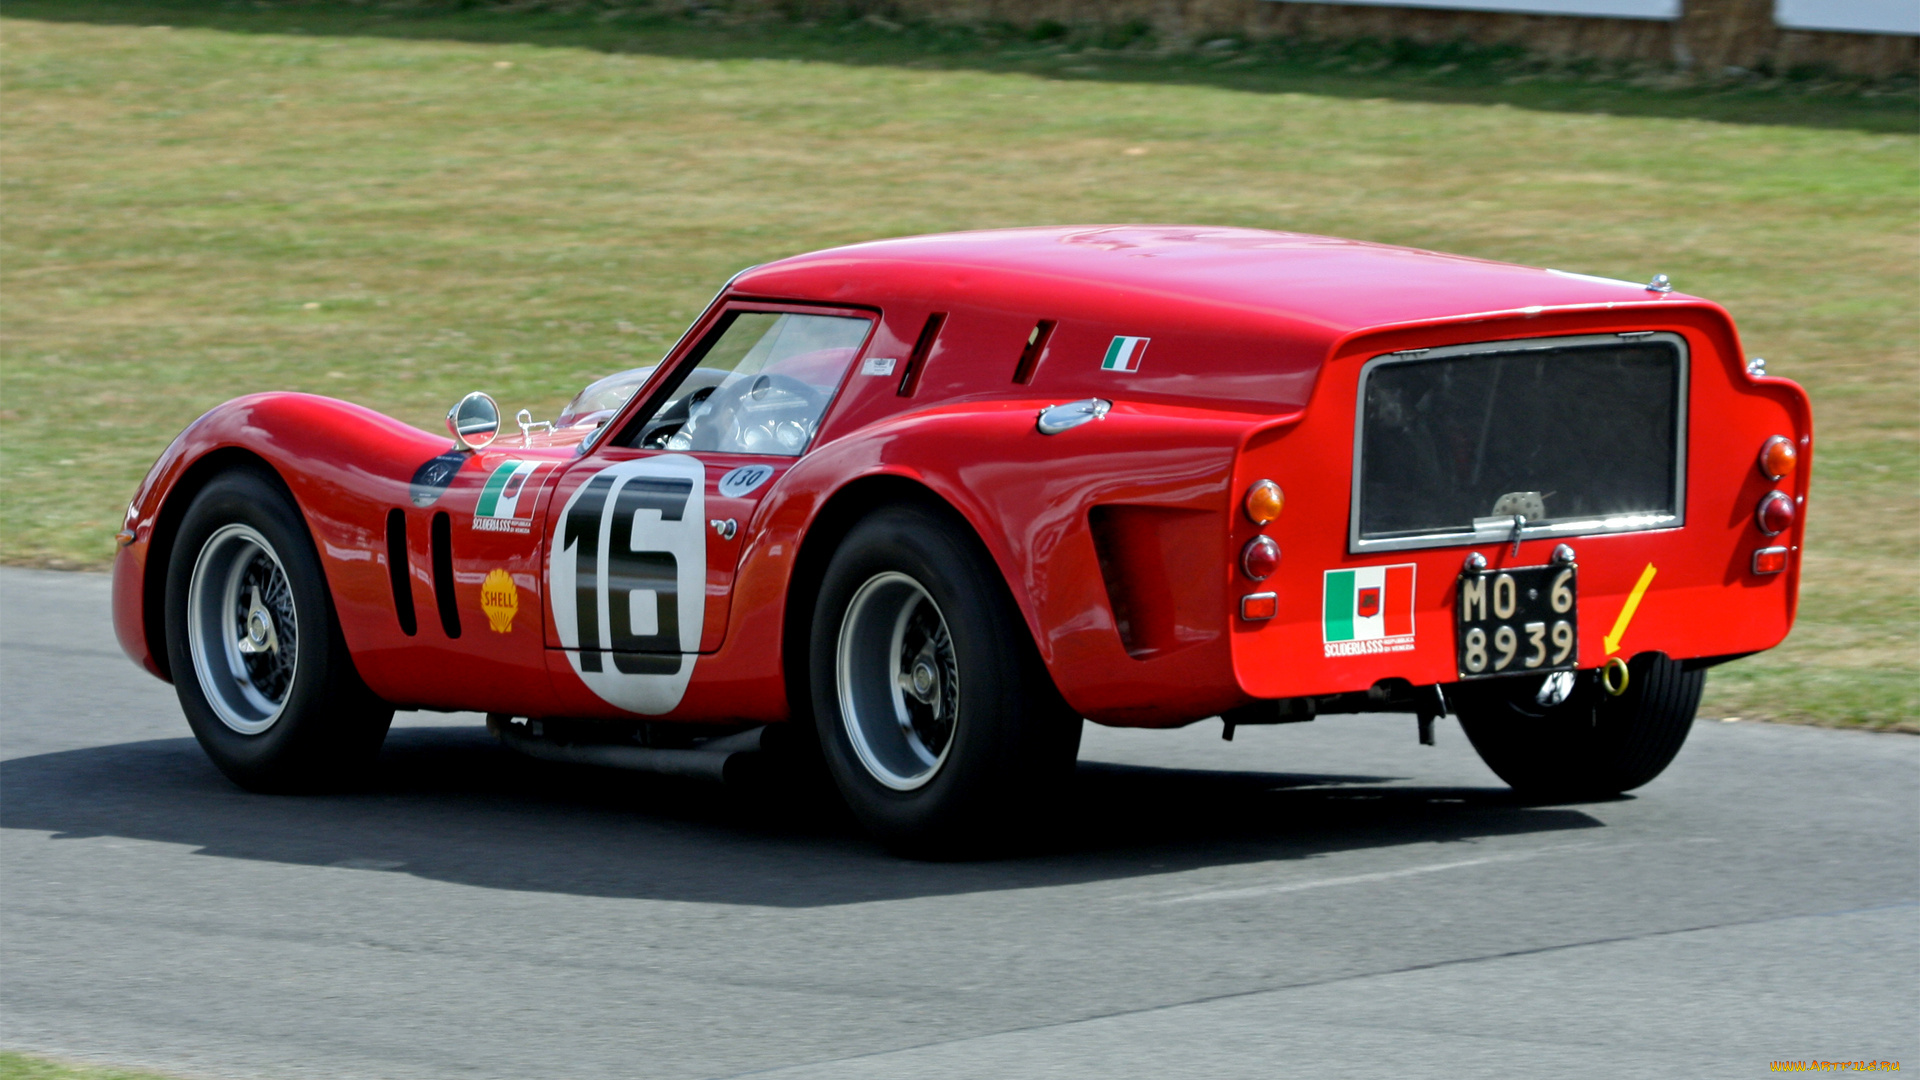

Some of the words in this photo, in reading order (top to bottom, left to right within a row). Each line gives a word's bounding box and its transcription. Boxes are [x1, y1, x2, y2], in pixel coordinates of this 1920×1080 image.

[727, 469, 764, 487] 130
[472, 517, 499, 531] SCUDERIA
[563, 475, 694, 675] 16
[485, 591, 514, 608] SHELL
[1464, 574, 1516, 622] MO
[1551, 568, 1573, 613] 6
[1324, 641, 1366, 658] SCUDERIA
[1366, 640, 1383, 654] SSS
[1466, 620, 1573, 672] 8939
